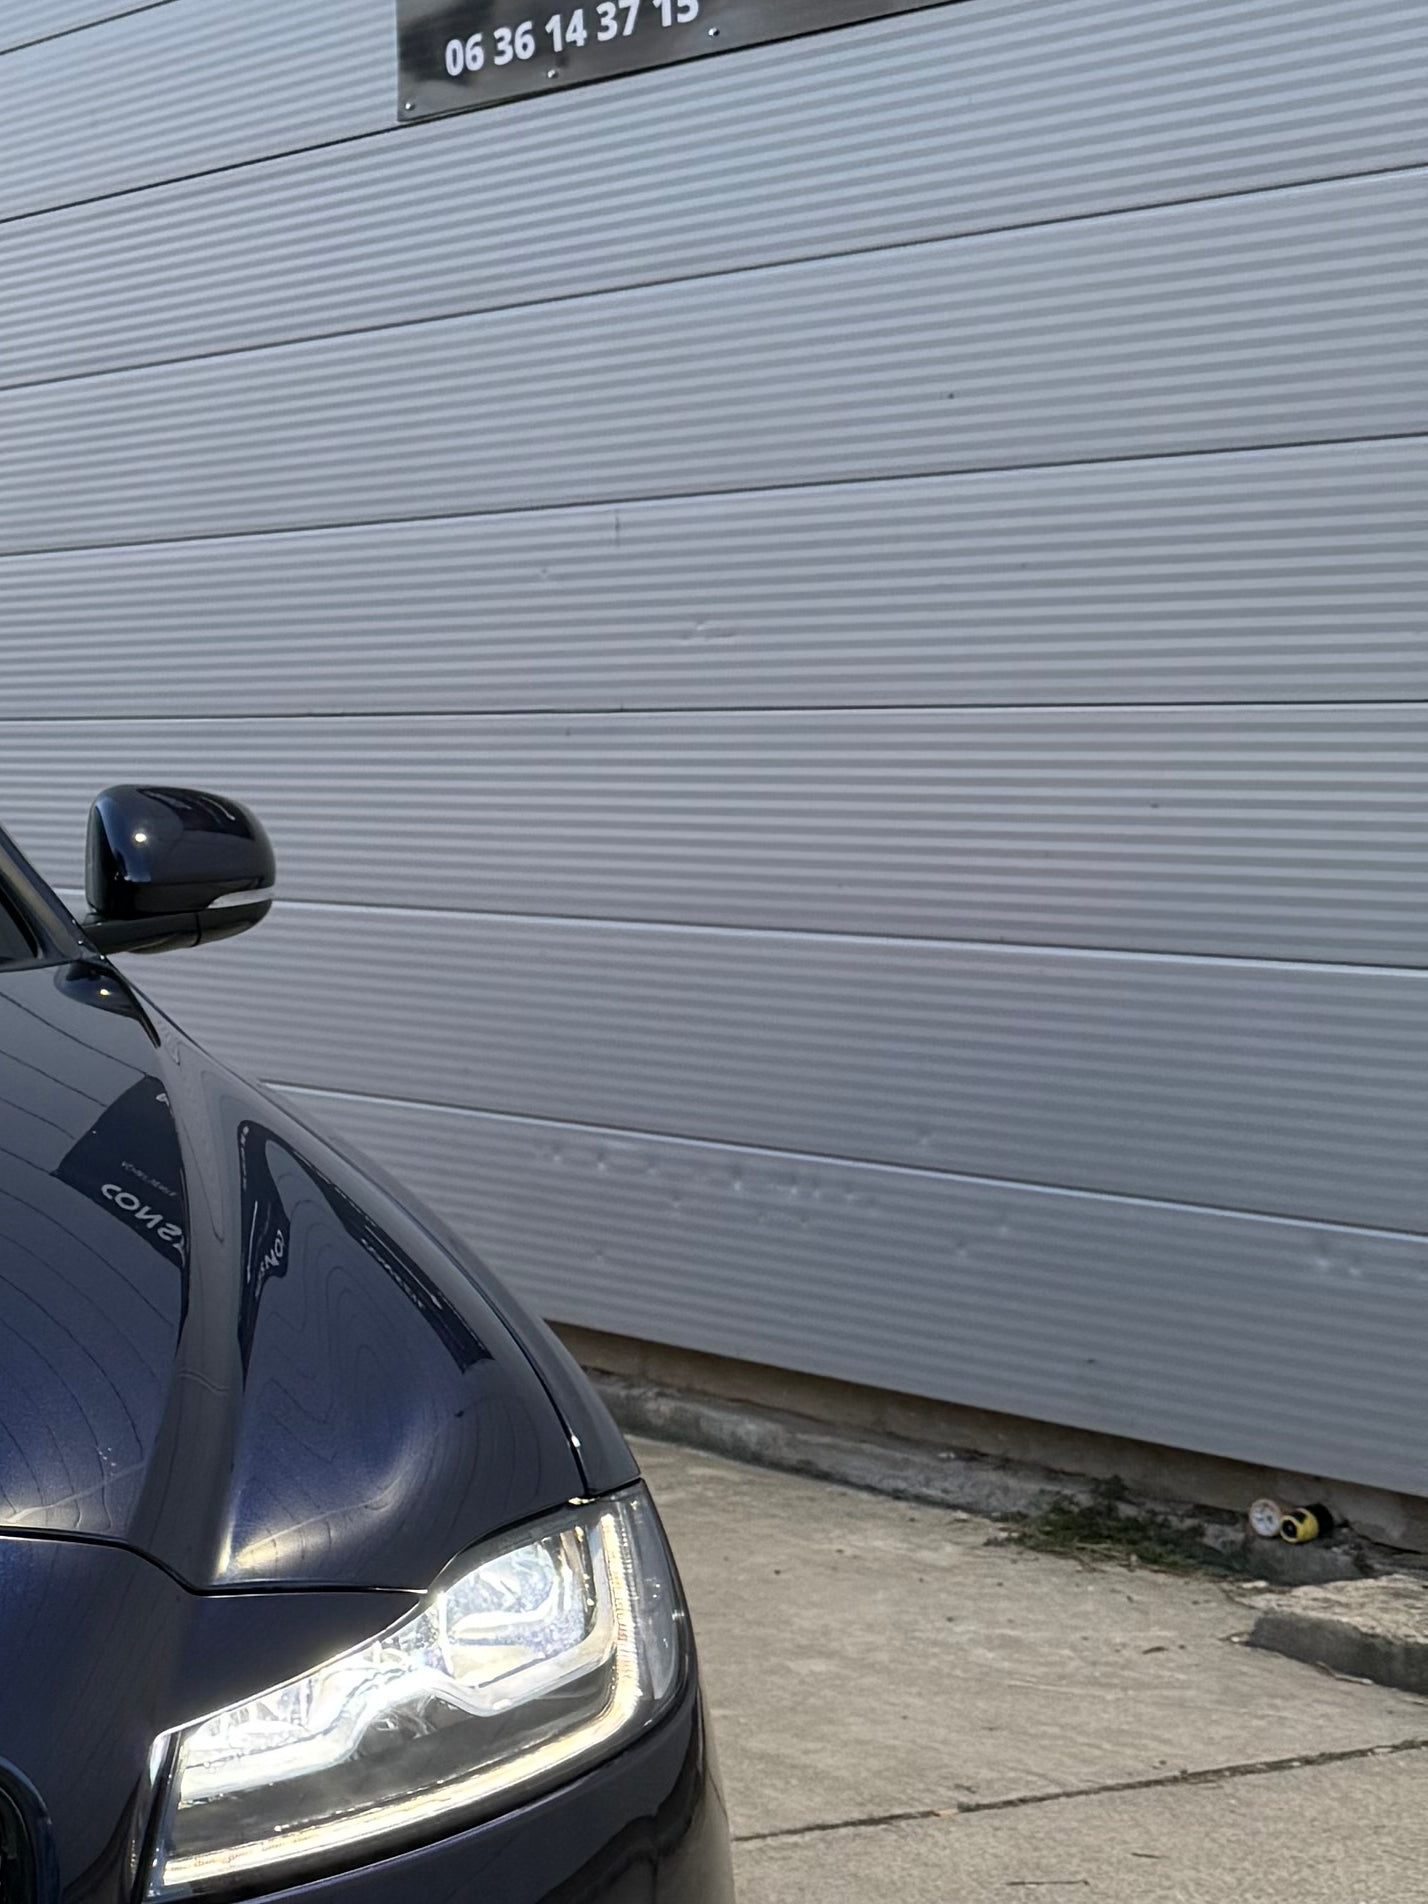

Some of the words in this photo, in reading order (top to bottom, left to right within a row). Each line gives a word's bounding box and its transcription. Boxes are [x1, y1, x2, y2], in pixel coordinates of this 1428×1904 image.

[445, 32, 484, 76] 06
[493, 21, 535, 66] 36
[545, 8, 587, 52] 14
